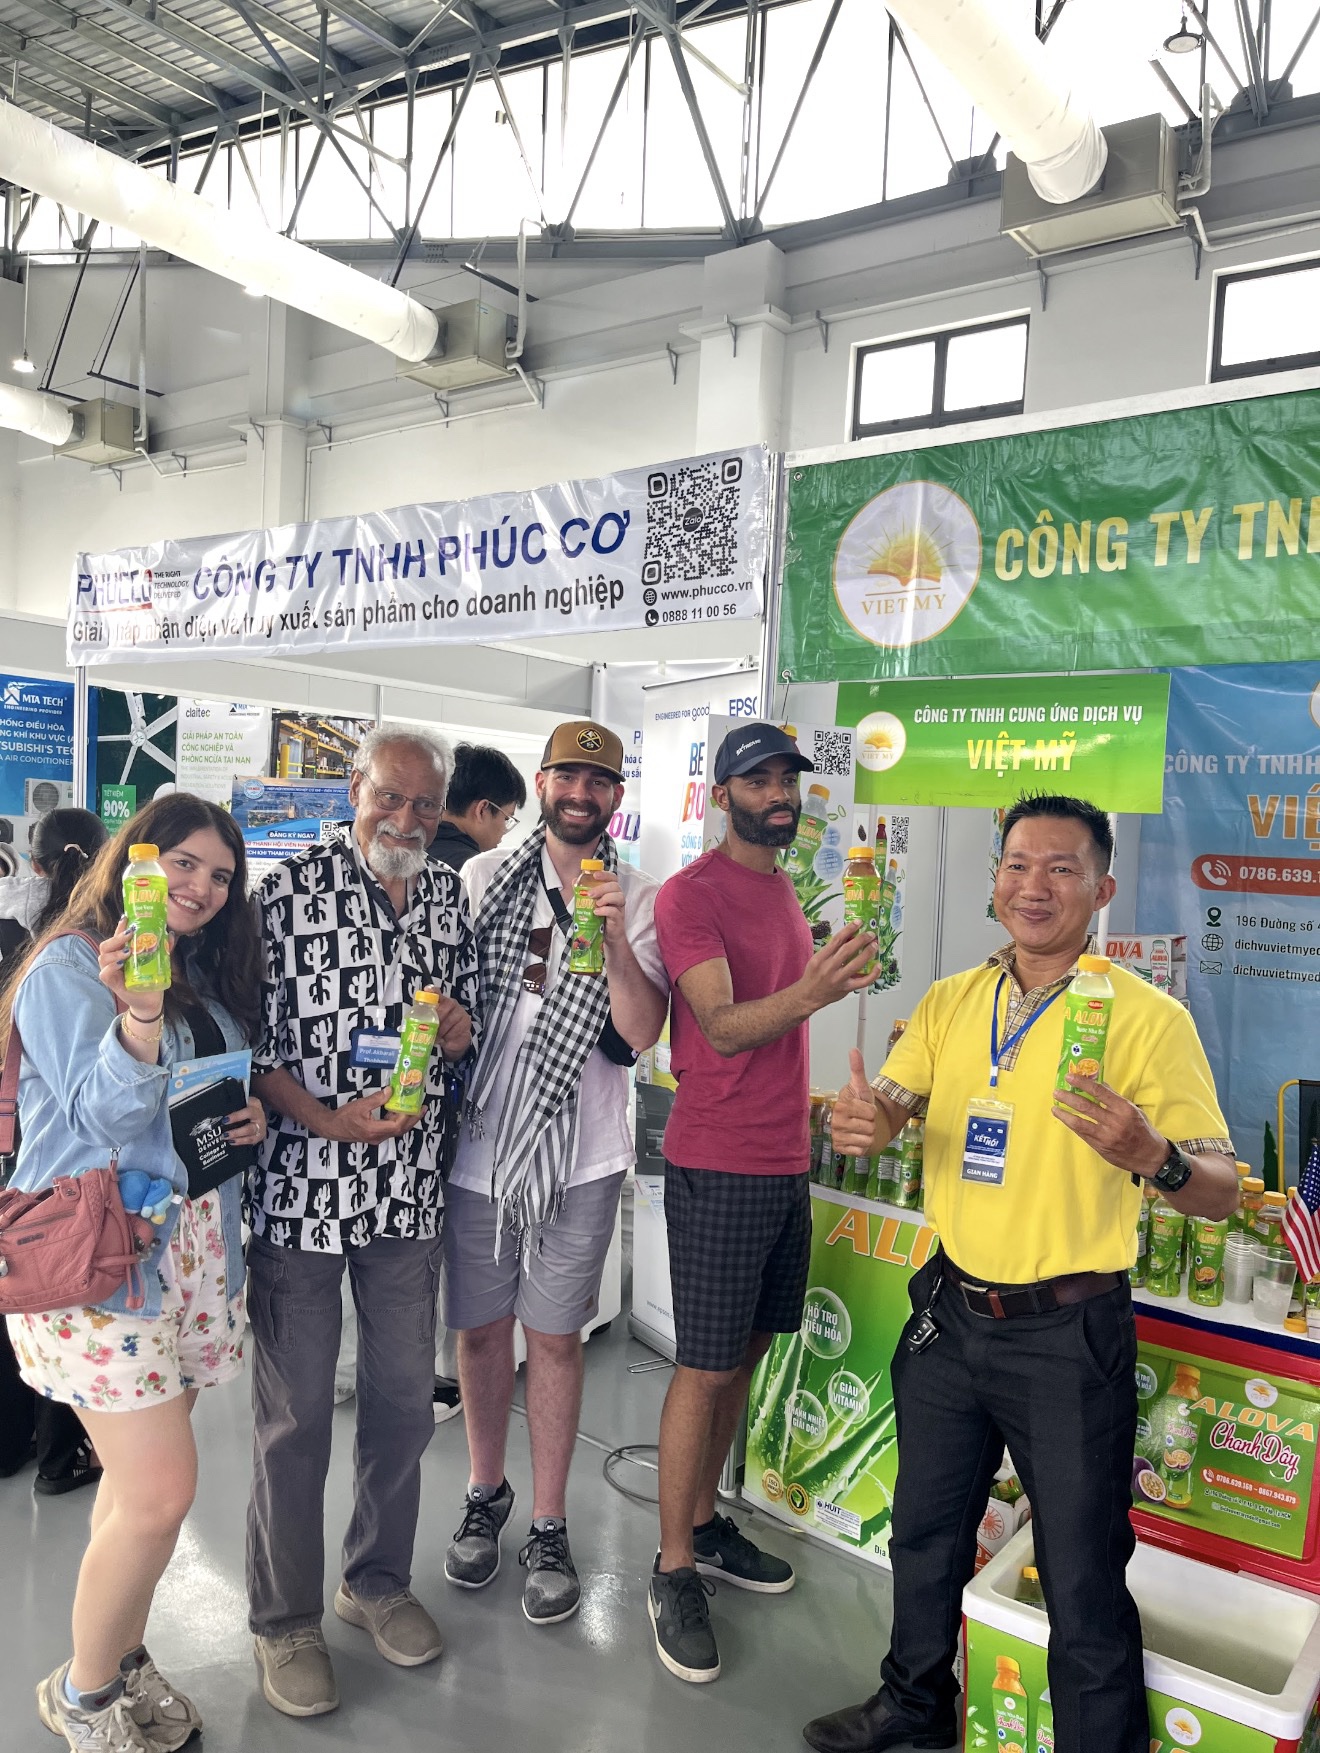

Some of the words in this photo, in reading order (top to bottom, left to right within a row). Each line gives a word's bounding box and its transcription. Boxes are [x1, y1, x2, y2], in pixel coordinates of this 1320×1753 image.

[684, 514, 703, 526] Zalo
[994, 510, 1128, 581] CÔNG
[1150, 508, 1213, 567] TY
[193, 555, 276, 600] CÔNG
[285, 552, 322, 590] TY
[332, 539, 426, 586] TNHH
[438, 515, 549, 576] PHÚC
[560, 510, 631, 558] CƠ
[661, 581, 753, 601] www.phucco.vn
[73, 620, 103, 641] Giải
[324, 600, 356, 627] sản
[363, 592, 416, 631] phẩm
[421, 594, 459, 620] cho
[466, 585, 536, 617] doanh
[545, 574, 624, 615] nghiệp
[662, 609, 688, 623] 0888
[691, 608, 703, 621] 11
[706, 606, 719, 619] 00
[723, 604, 737, 617] 56
[861, 596, 909, 616] VIET
[913, 594, 948, 612] MY
[23, 694, 40, 704] MTA
[42, 696, 64, 707] TECH
[186, 707, 211, 718] claitec
[682, 709, 691, 717] FOR
[914, 705, 948, 723] CÔNG
[952, 708, 966, 723] TY
[970, 707, 1005, 723] TNHH
[1009, 706, 1046, 723] CUNG
[1050, 702, 1079, 722] ỨNG
[1083, 705, 1119, 726] DỊCH
[1123, 705, 1143, 725] VỤ
[13, 730, 28, 738] KHÍ
[29, 731, 47, 740] KHU
[47, 723, 65, 731] HÒA
[195, 731, 212, 740] PHÁP
[225, 732, 243, 740] TOÀN
[181, 743, 199, 751] CÔNG
[200, 742, 224, 753] NGHIỆP
[225, 743, 234, 751] VÀ
[967, 731, 1026, 778] VIỆT
[1034, 730, 1077, 771] MỸ
[223, 756, 234, 764] TAI
[625, 754, 637, 764] hóa
[689, 742, 705, 776] BE
[1164, 749, 1218, 774] CÔNG
[1225, 755, 1250, 774] TY
[104, 800, 130, 818] 90%
[1236, 915, 1257, 928] 196
[1260, 917, 1297, 932] Đường
[1300, 919, 1314, 932] số
[196, 1126, 222, 1147] MSU
[199, 1146, 220, 1160] College
[202, 1150, 226, 1165] Business
[966, 1168, 981, 1176] GIAN
[982, 1169, 998, 1179] HÀNG
[807, 1302, 820, 1319] HỖ
[821, 1309, 838, 1326] TRỢ
[824, 1324, 842, 1343] HÓA
[839, 1381, 859, 1397] GIÀU
[833, 1392, 864, 1413] VITAMIN
[1189, 1396, 1315, 1442] ALOVA
[1210, 1421, 1261, 1462] Chanh
[1261, 1434, 1300, 1482] Dây
[824, 1501, 841, 1515] HUIT
